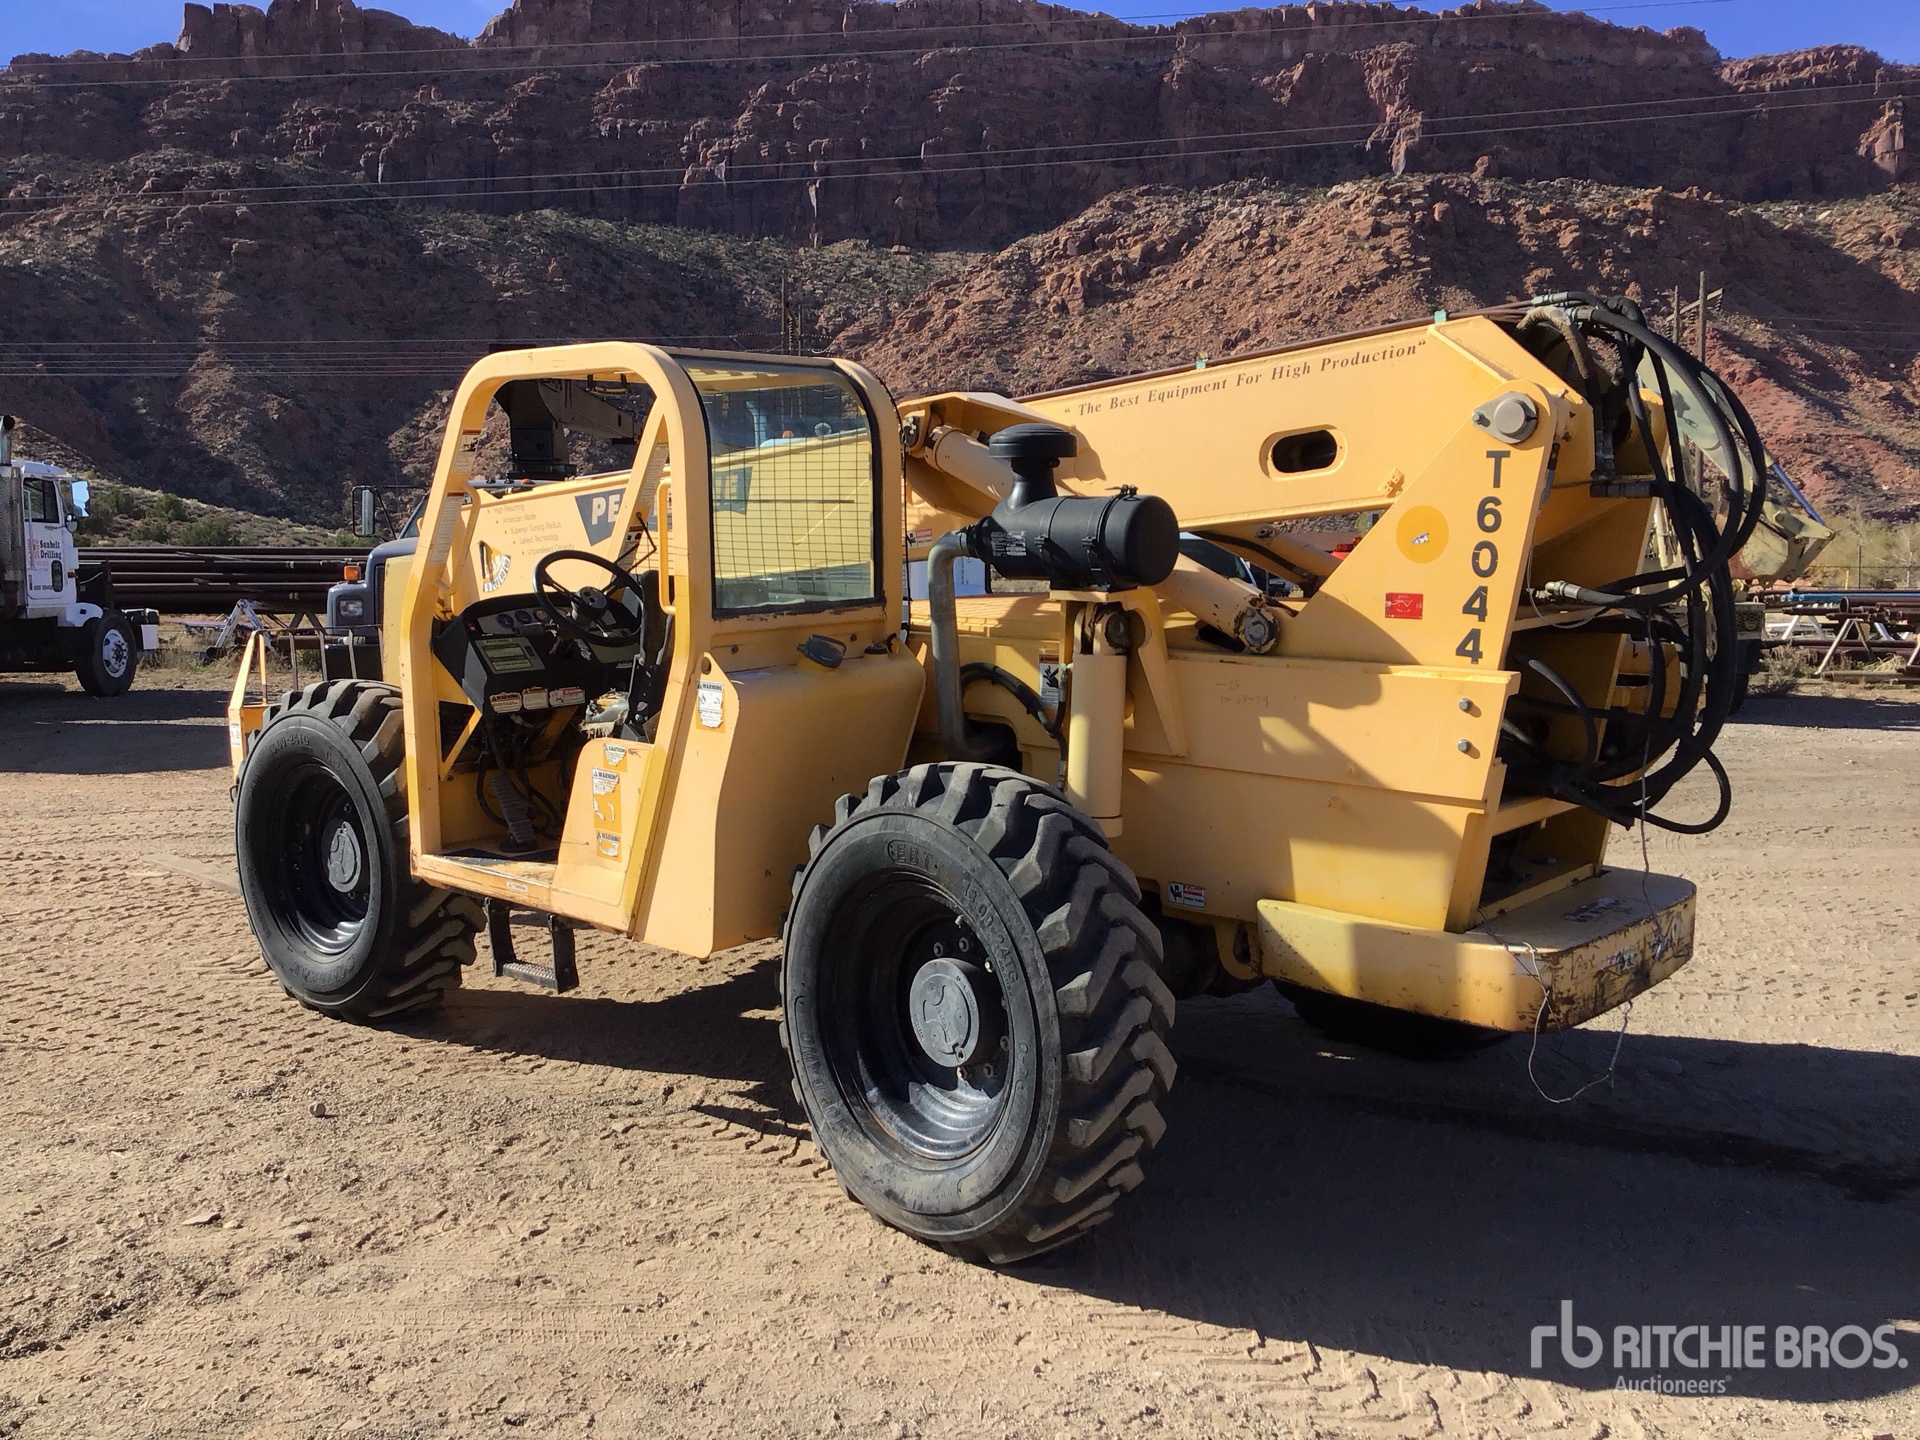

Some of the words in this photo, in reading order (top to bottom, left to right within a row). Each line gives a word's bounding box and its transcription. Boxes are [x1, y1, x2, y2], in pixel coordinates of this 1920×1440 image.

[1079, 402, 1102, 416] The
[1110, 395, 1139, 410] Best
[1148, 378, 1227, 402] Equipment
[1236, 372, 1262, 387] For
[1271, 362, 1310, 380] High
[40, 540, 61, 549] Sunbelt
[40, 550, 62, 560] Drilling
